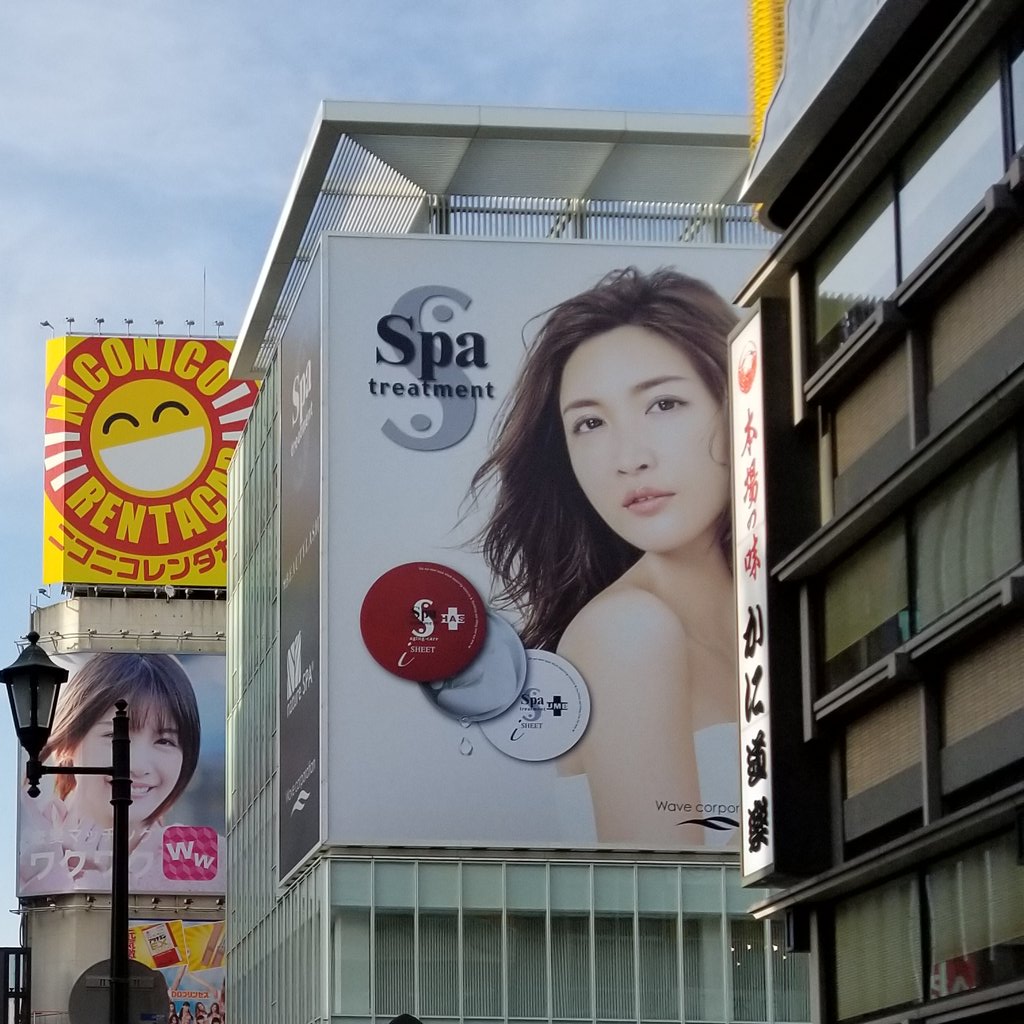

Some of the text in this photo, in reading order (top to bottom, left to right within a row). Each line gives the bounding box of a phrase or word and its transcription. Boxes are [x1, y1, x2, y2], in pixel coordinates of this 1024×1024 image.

[376, 314, 488, 381] Spa
[46, 337, 230, 426] NICONICO
[368, 378, 495, 399] treatment
[655, 800, 692, 812] Wave
